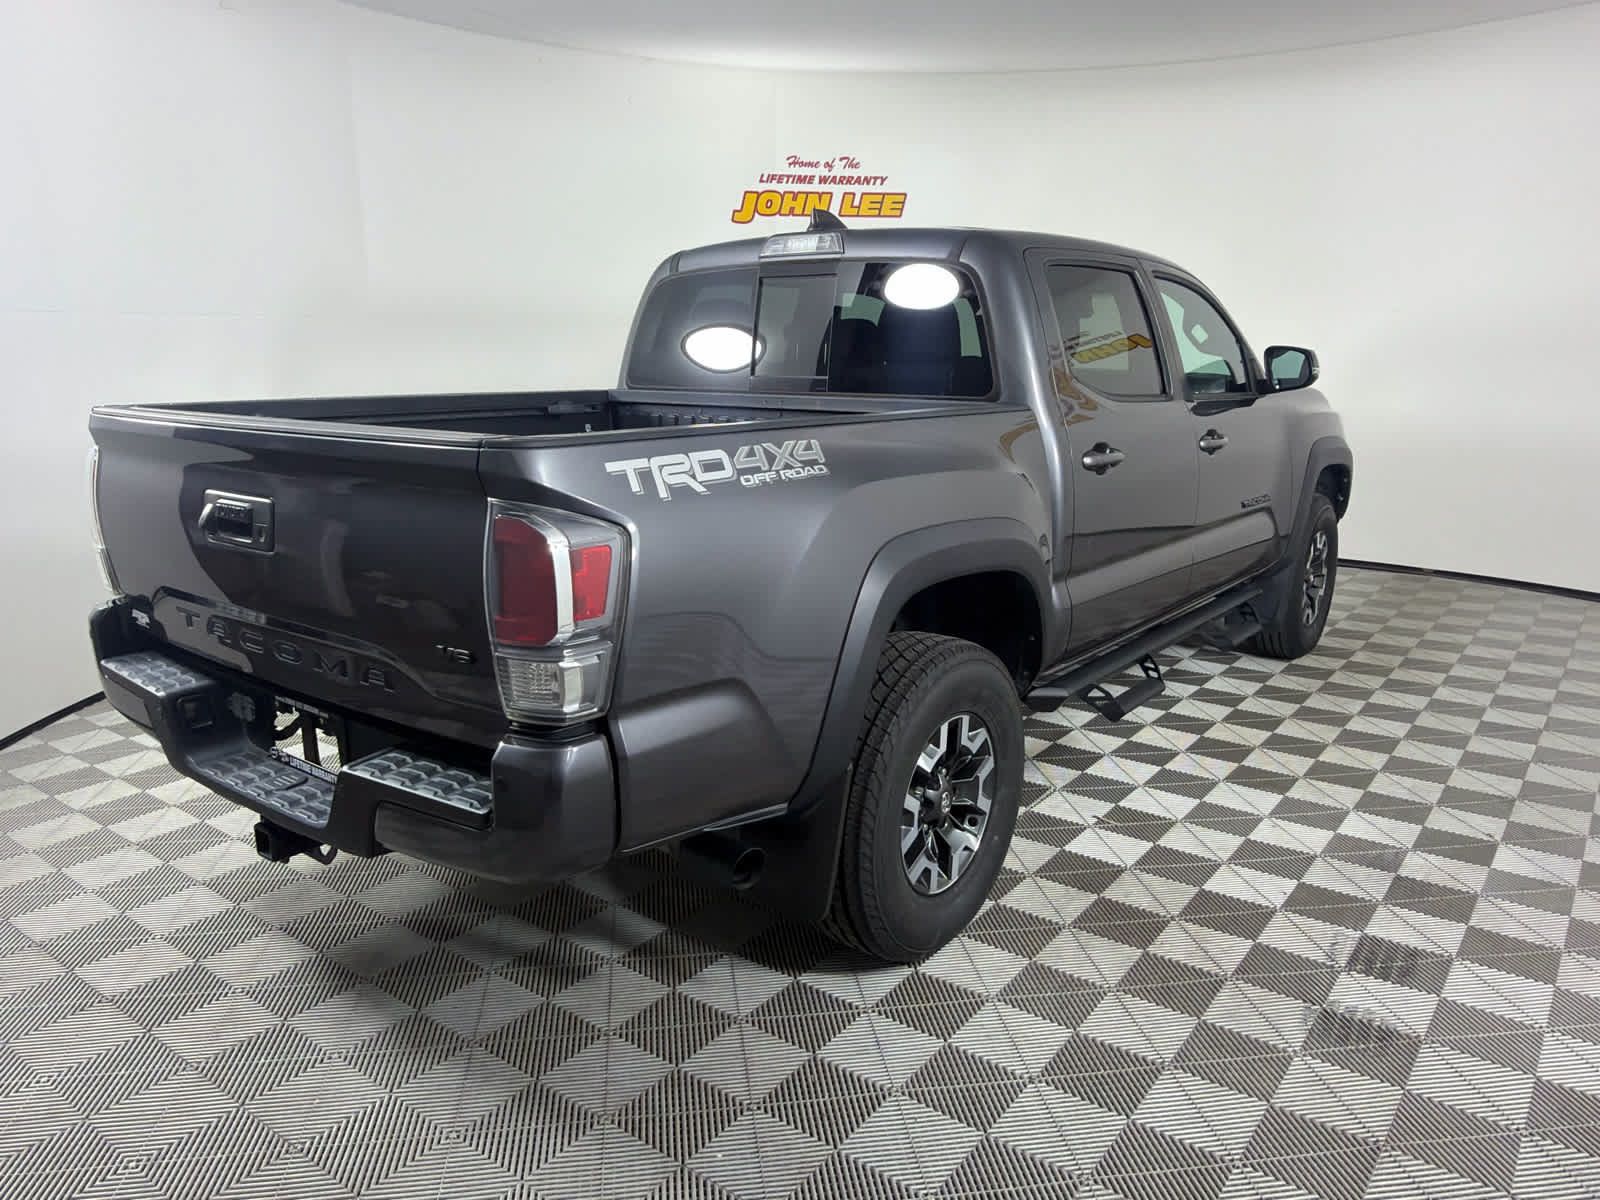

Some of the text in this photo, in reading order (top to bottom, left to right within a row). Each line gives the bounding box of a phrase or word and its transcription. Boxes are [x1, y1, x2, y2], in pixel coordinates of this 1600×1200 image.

[786, 155, 861, 172] Home of The
[759, 174, 888, 186] LIFETIME WARRANTY
[731, 190, 907, 224] JOHN LEE
[604, 439, 826, 501] TRD 4X4
[740, 464, 829, 487] OFF ROAD
[175, 605, 396, 694] TACOMA
